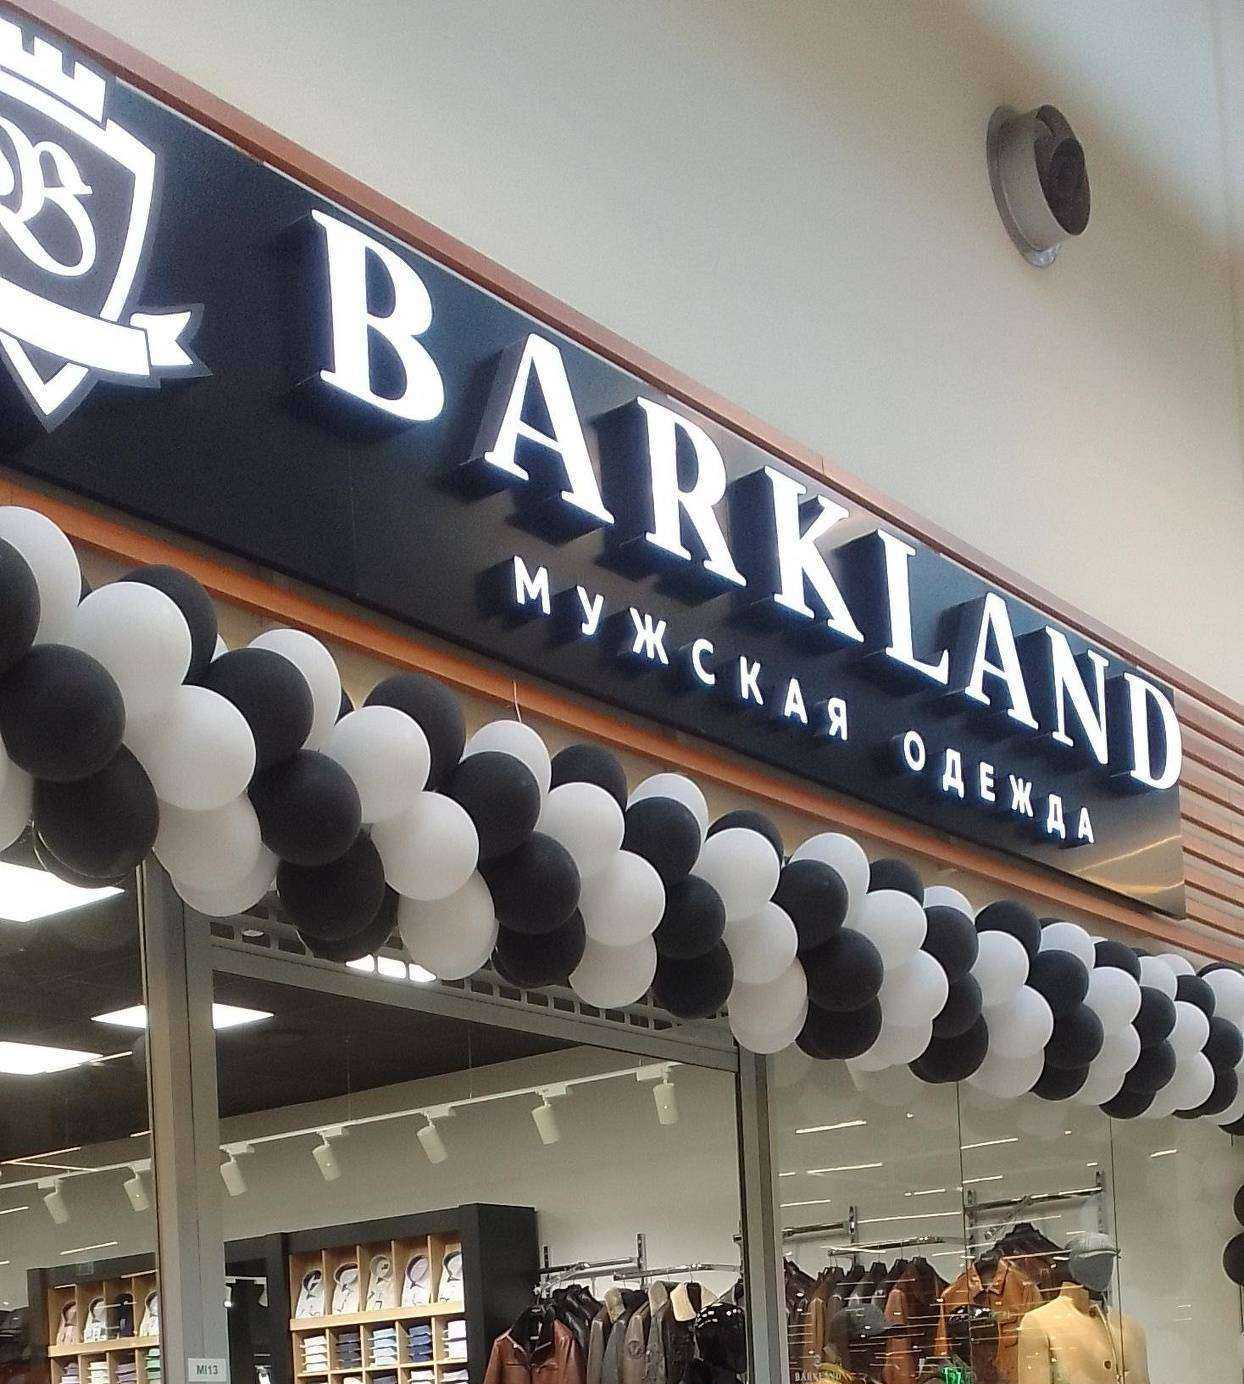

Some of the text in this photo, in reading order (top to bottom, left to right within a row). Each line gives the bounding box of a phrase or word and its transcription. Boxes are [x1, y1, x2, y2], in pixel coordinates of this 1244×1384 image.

[312, 209, 1183, 790] BARKLAND
[514, 555, 1095, 844] МУЖСКАЯ ОДЕЖДА
